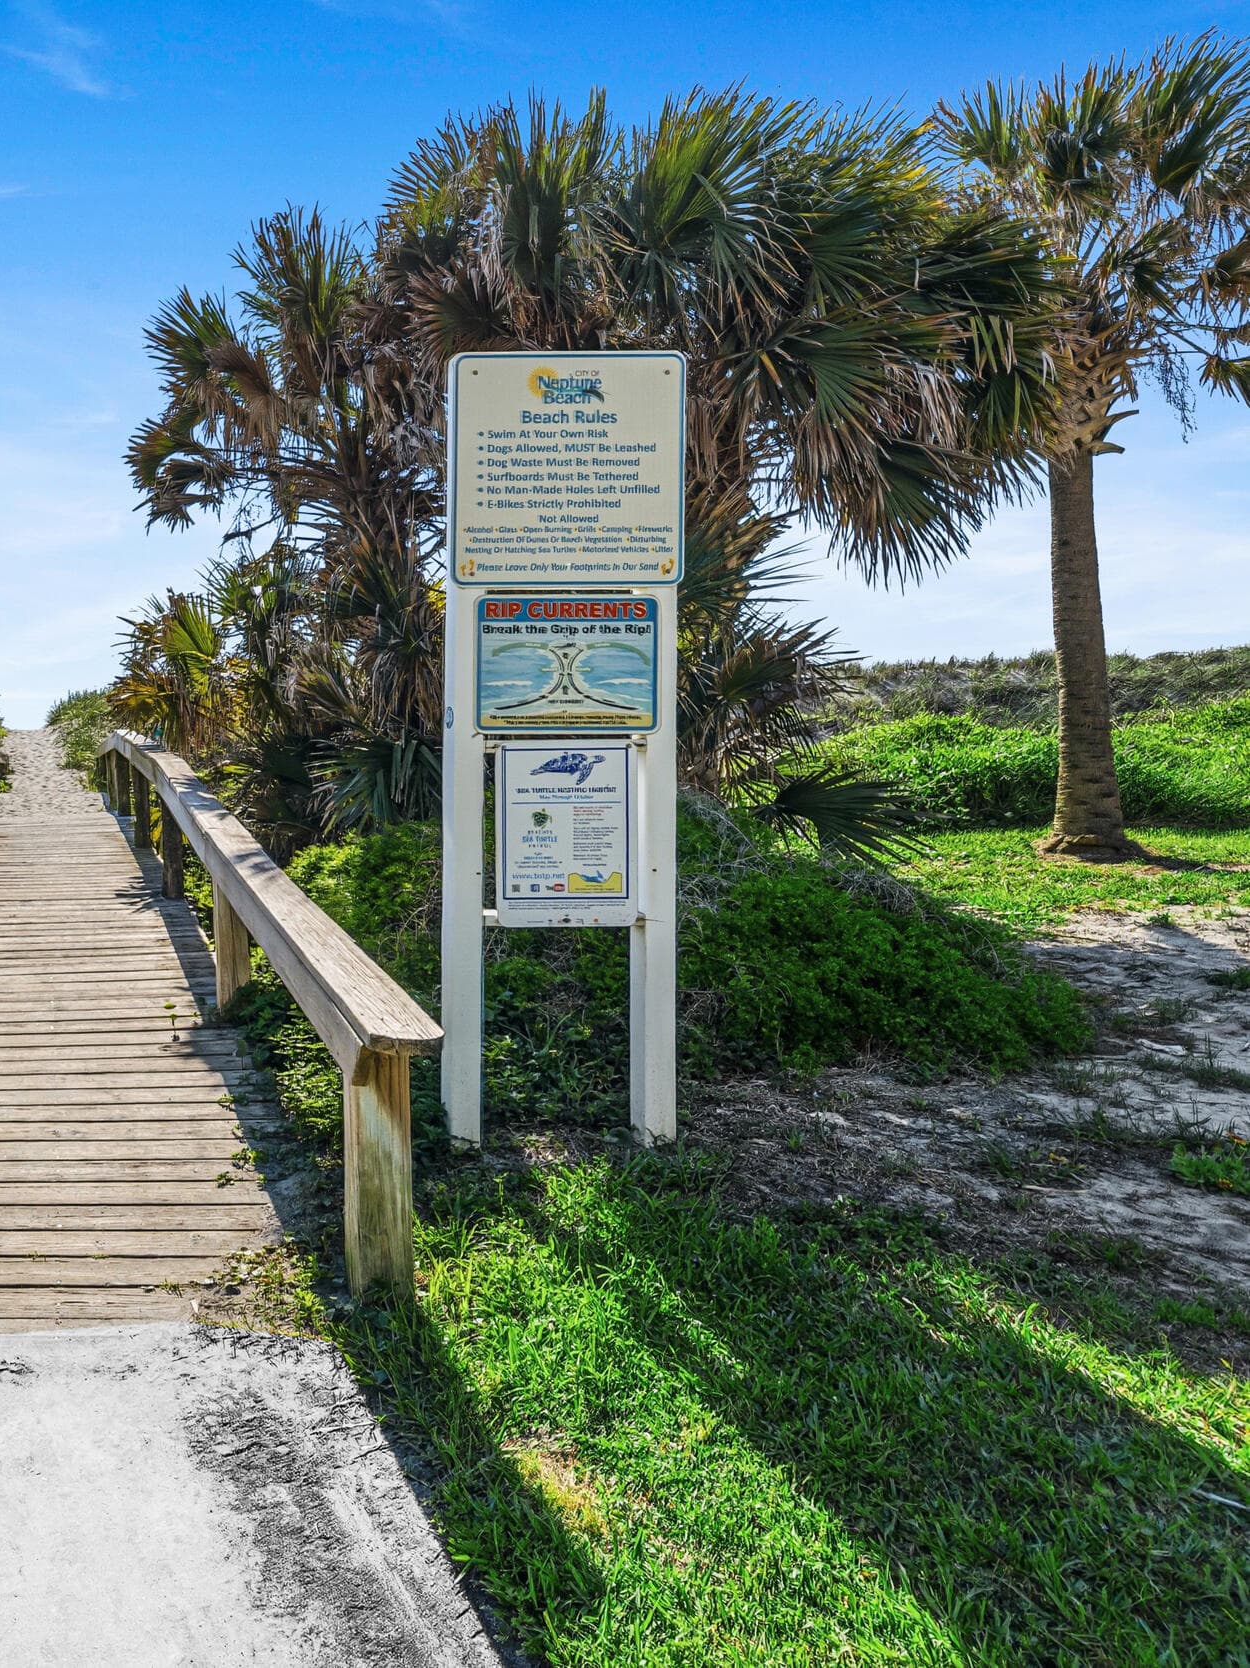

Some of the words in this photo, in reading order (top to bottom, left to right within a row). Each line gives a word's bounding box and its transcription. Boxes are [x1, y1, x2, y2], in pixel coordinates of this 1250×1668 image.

[538, 376, 602, 392] Neptune
[544, 390, 590, 404] Beach
[522, 411, 569, 423] Beach
[575, 411, 617, 423] Rules
[488, 430, 516, 438] Swim
[519, 430, 530, 438] At
[534, 430, 557, 438] Your
[560, 430, 584, 438] Own
[587, 430, 608, 438] Risk
[487, 444, 513, 455] Dogs
[516, 444, 562, 454] Allowed,
[565, 444, 595, 452] MUST
[599, 444, 611, 452] Be
[615, 444, 656, 452] Leashed
[487, 458, 507, 469] Dog
[511, 458, 542, 467] Waste
[546, 458, 572, 467] Must
[576, 458, 589, 467] Be
[592, 458, 640, 467] Removed
[487, 472, 544, 481] Surfboards
[548, 472, 574, 481] Must
[577, 472, 590, 481] Be
[593, 472, 638, 481] Tethered
[487, 485, 501, 494] No
[505, 485, 562, 494] Man-Made
[566, 485, 594, 494] Holes
[597, 485, 616, 494] Left
[620, 485, 660, 494] Unfilled
[487, 499, 524, 509] E-Bikes
[528, 499, 563, 511] Strictly
[567, 499, 621, 509] Prohibited
[539, 515, 557, 523] Not
[560, 515, 599, 523] Allowed
[531, 563, 548, 573] Only
[486, 602, 522, 619] RIP
[528, 602, 647, 619] CURRENTS
[483, 625, 523, 634] Break
[526, 625, 547, 634] the
[551, 625, 578, 637] Grip
[583, 625, 596, 634] of
[599, 625, 621, 634] the
[625, 625, 651, 637] Rip!
